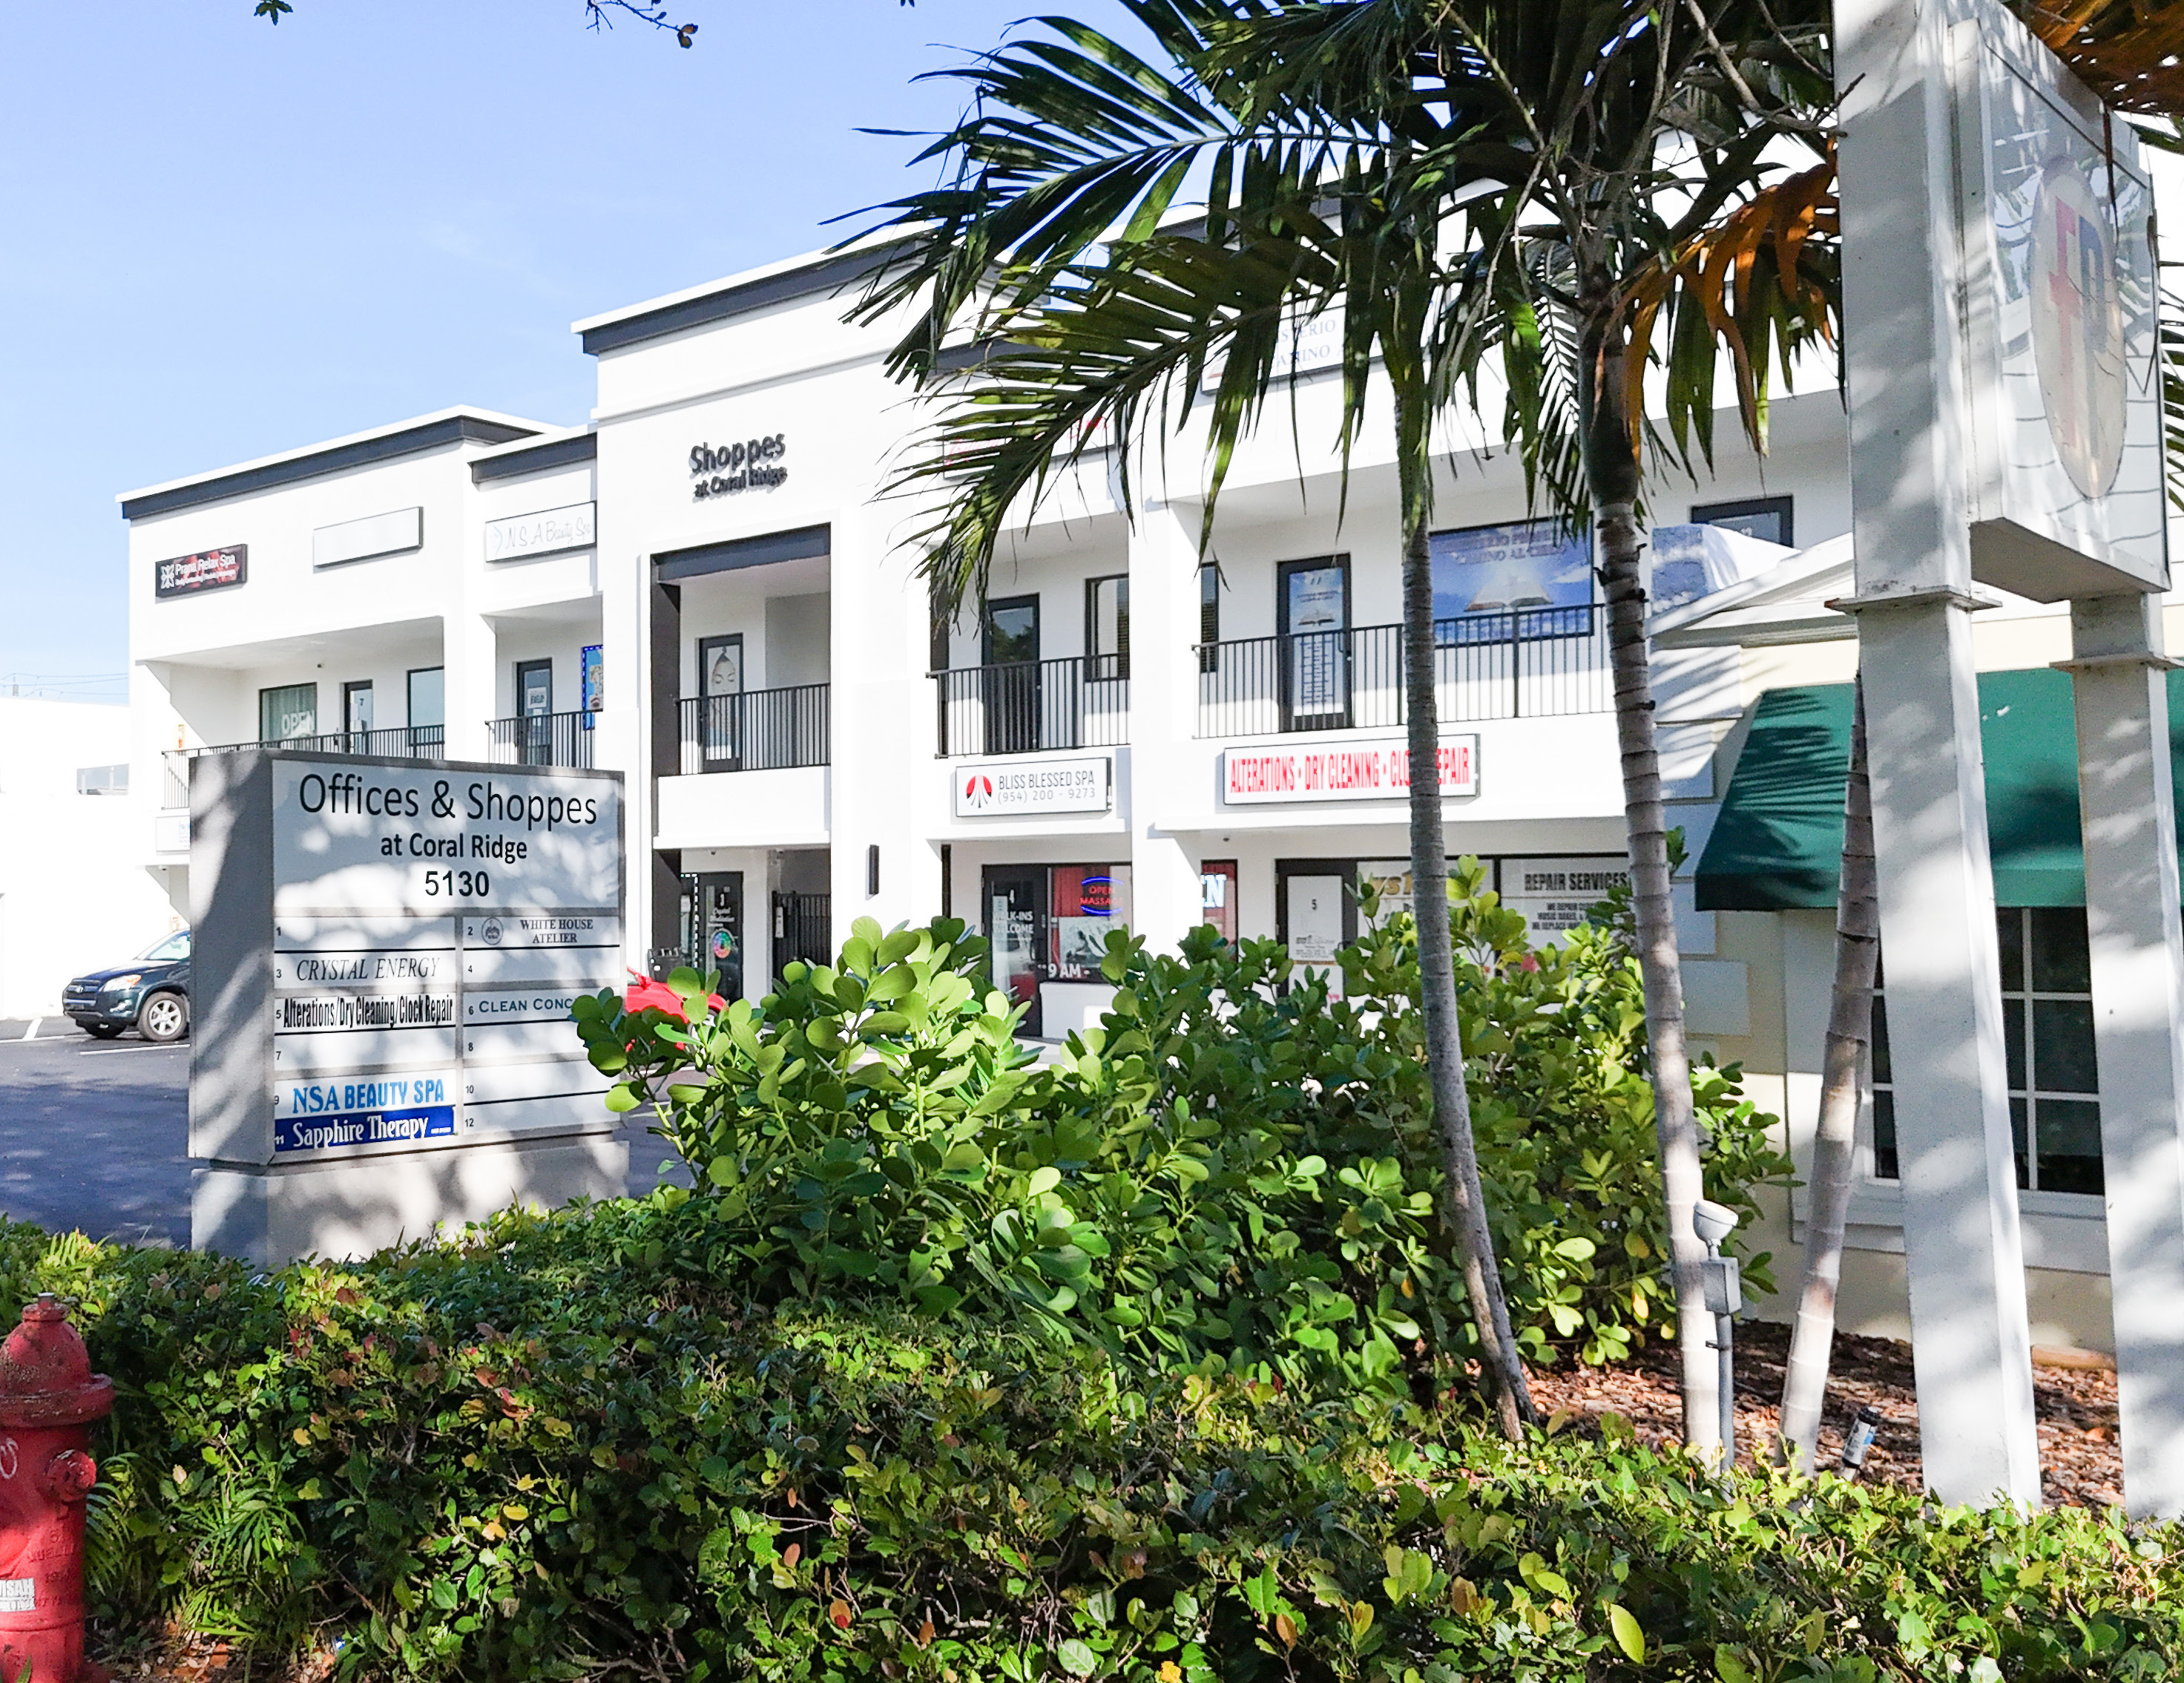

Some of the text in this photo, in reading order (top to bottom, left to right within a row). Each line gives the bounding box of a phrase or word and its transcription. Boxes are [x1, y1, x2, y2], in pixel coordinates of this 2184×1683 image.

[691, 433, 786, 473] Shoppes
[694, 464, 788, 498] at Coral Ridge
[174, 554, 237, 576] Prana Relax Spa
[360, 698, 364, 706] 7
[281, 709, 315, 735] OPEN
[1230, 747, 1470, 793] ALTERATIONS DRY CLEANING CLO EPAIR
[999, 770, 1095, 790] BLISS BLESSED SPA
[299, 772, 598, 831] Offices & Shoppes
[998, 791, 1028, 805] (954)
[1033, 790, 1053, 801] 200
[1068, 787, 1096, 799] 9273
[381, 833, 528, 864] at Coral Ridge
[424, 870, 490, 896] 5130
[1524, 872, 1628, 891] REPAIR SERVICES
[1009, 889, 1015, 903] 4
[1088, 885, 1116, 894] OPEN
[1311, 898, 1318, 911] 5
[276, 927, 281, 936] 1
[467, 926, 473, 936] 2
[519, 919, 593, 930] WHITE HOUSE
[531, 933, 578, 944] ATELIER
[276, 969, 282, 979] 3
[296, 957, 441, 981] CRYSTAL ENERGY
[1047, 963, 1057, 978] 9
[1059, 963, 1082, 979] AM
[425, 994, 453, 1026] Repair
[468, 1005, 474, 1015] 6
[478, 998, 576, 1014] CLEAN CONC
[275, 1009, 282, 1019] 5
[468, 1043, 473, 1052] 8
[275, 1051, 282, 1060] 7
[292, 1079, 444, 1113] NSA BEAUTY SPA
[466, 1085, 474, 1094] 10
[274, 1095, 280, 1106] 9
[465, 1118, 474, 1127] 12
[274, 1135, 284, 1144] 11
[292, 1115, 429, 1149] Sapphire Therapy
